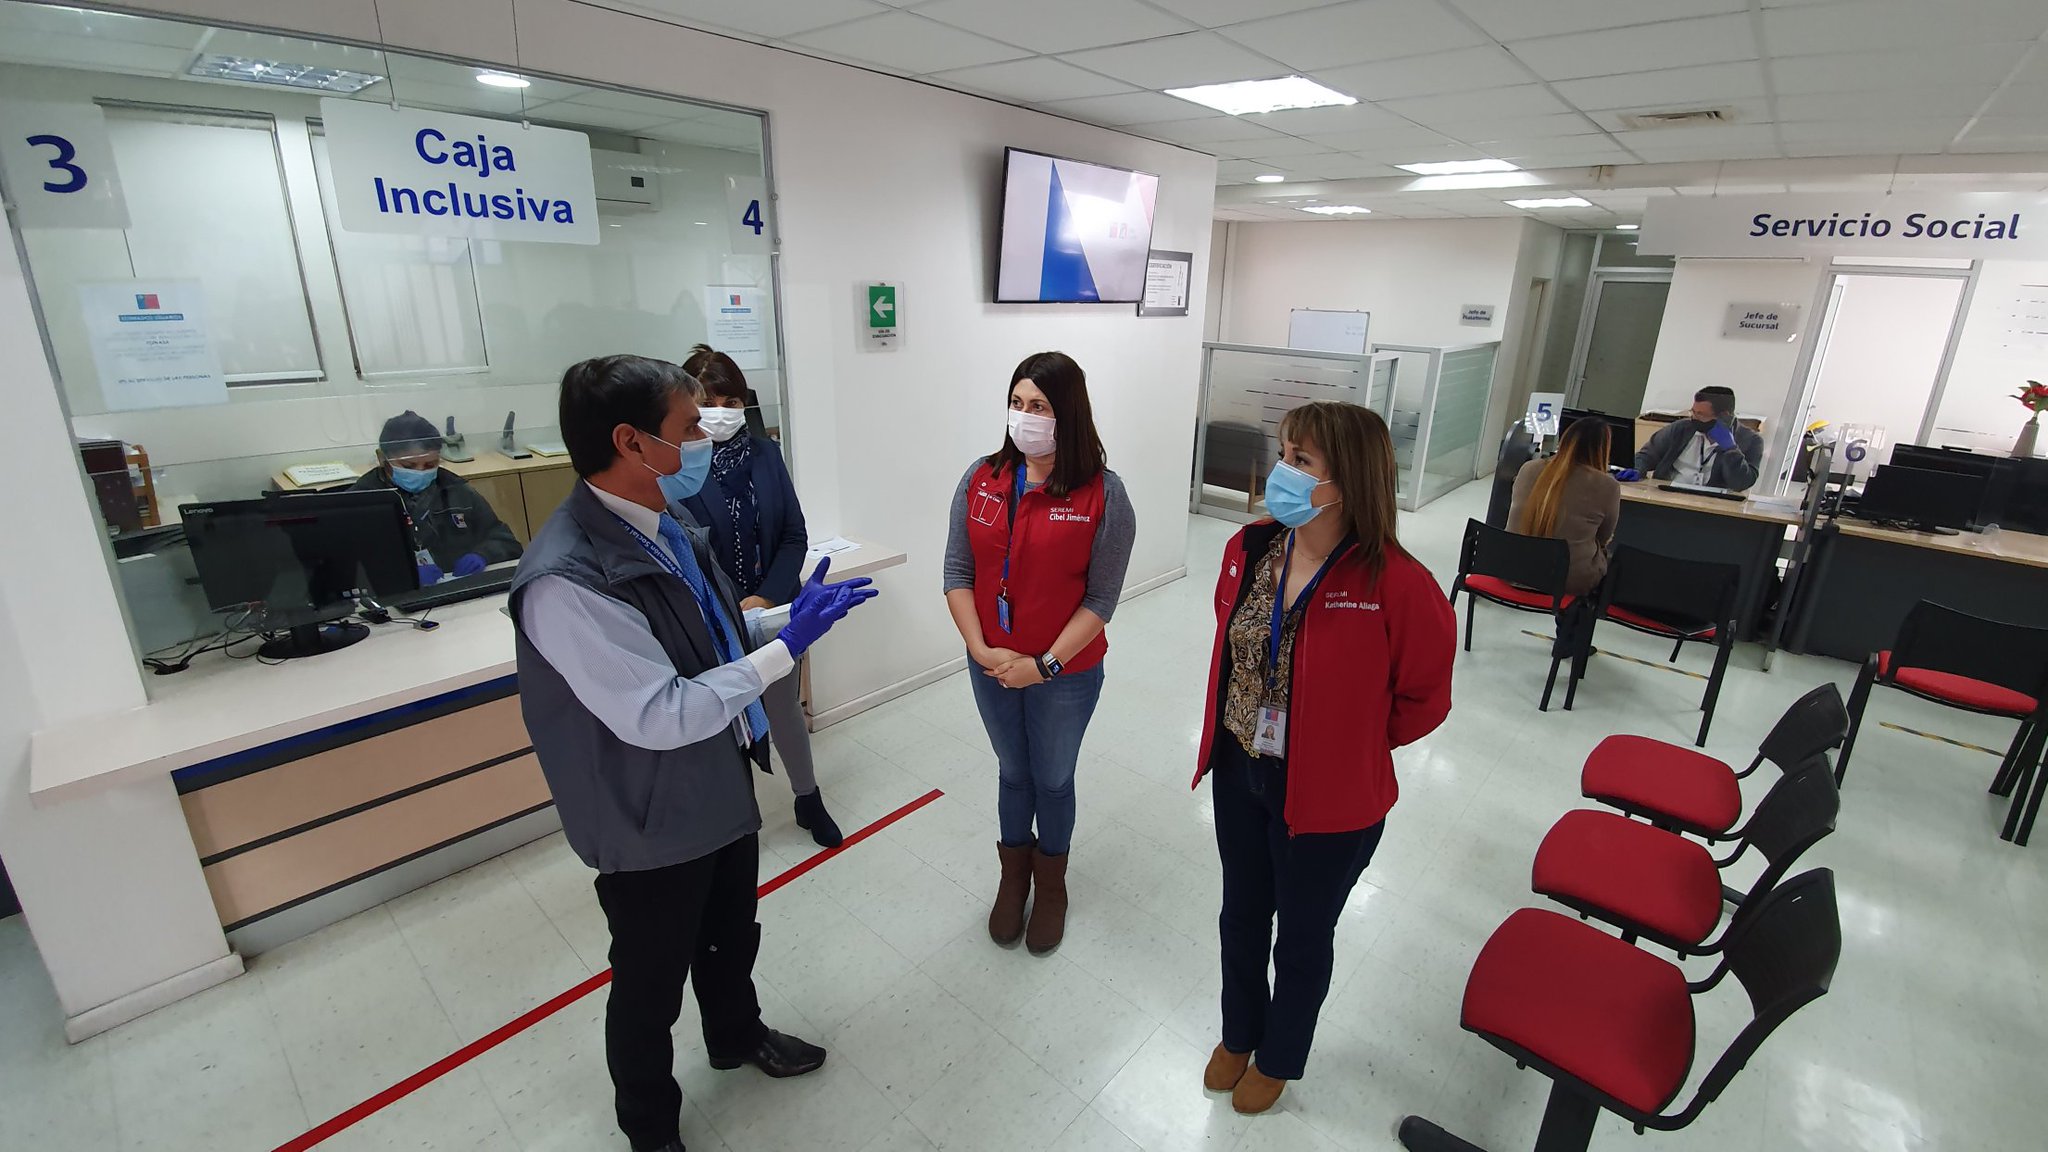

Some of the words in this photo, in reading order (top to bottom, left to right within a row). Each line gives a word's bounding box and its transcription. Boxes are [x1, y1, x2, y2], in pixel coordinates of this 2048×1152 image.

[415, 128, 516, 177] Caja
[26, 134, 87, 193] 3
[374, 177, 574, 224] Inclusiva
[742, 199, 764, 235] 4
[1750, 213, 1892, 237] Servicio
[1902, 213, 2020, 240] Social
[1739, 320, 1779, 330] Sucursal
[1744, 312, 1764, 320] Jefe
[1537, 403, 1551, 421] 5
[1846, 440, 1867, 462] 6
[1049, 513, 1065, 521] Cibel
[1066, 513, 1090, 522] Jiménez
[629, 530, 651, 548] Social
[650, 544, 676, 571] Previsión
[675, 569, 684, 578] de
[1325, 601, 1358, 609] Katherine
[1358, 602, 1380, 611] Aliaga
